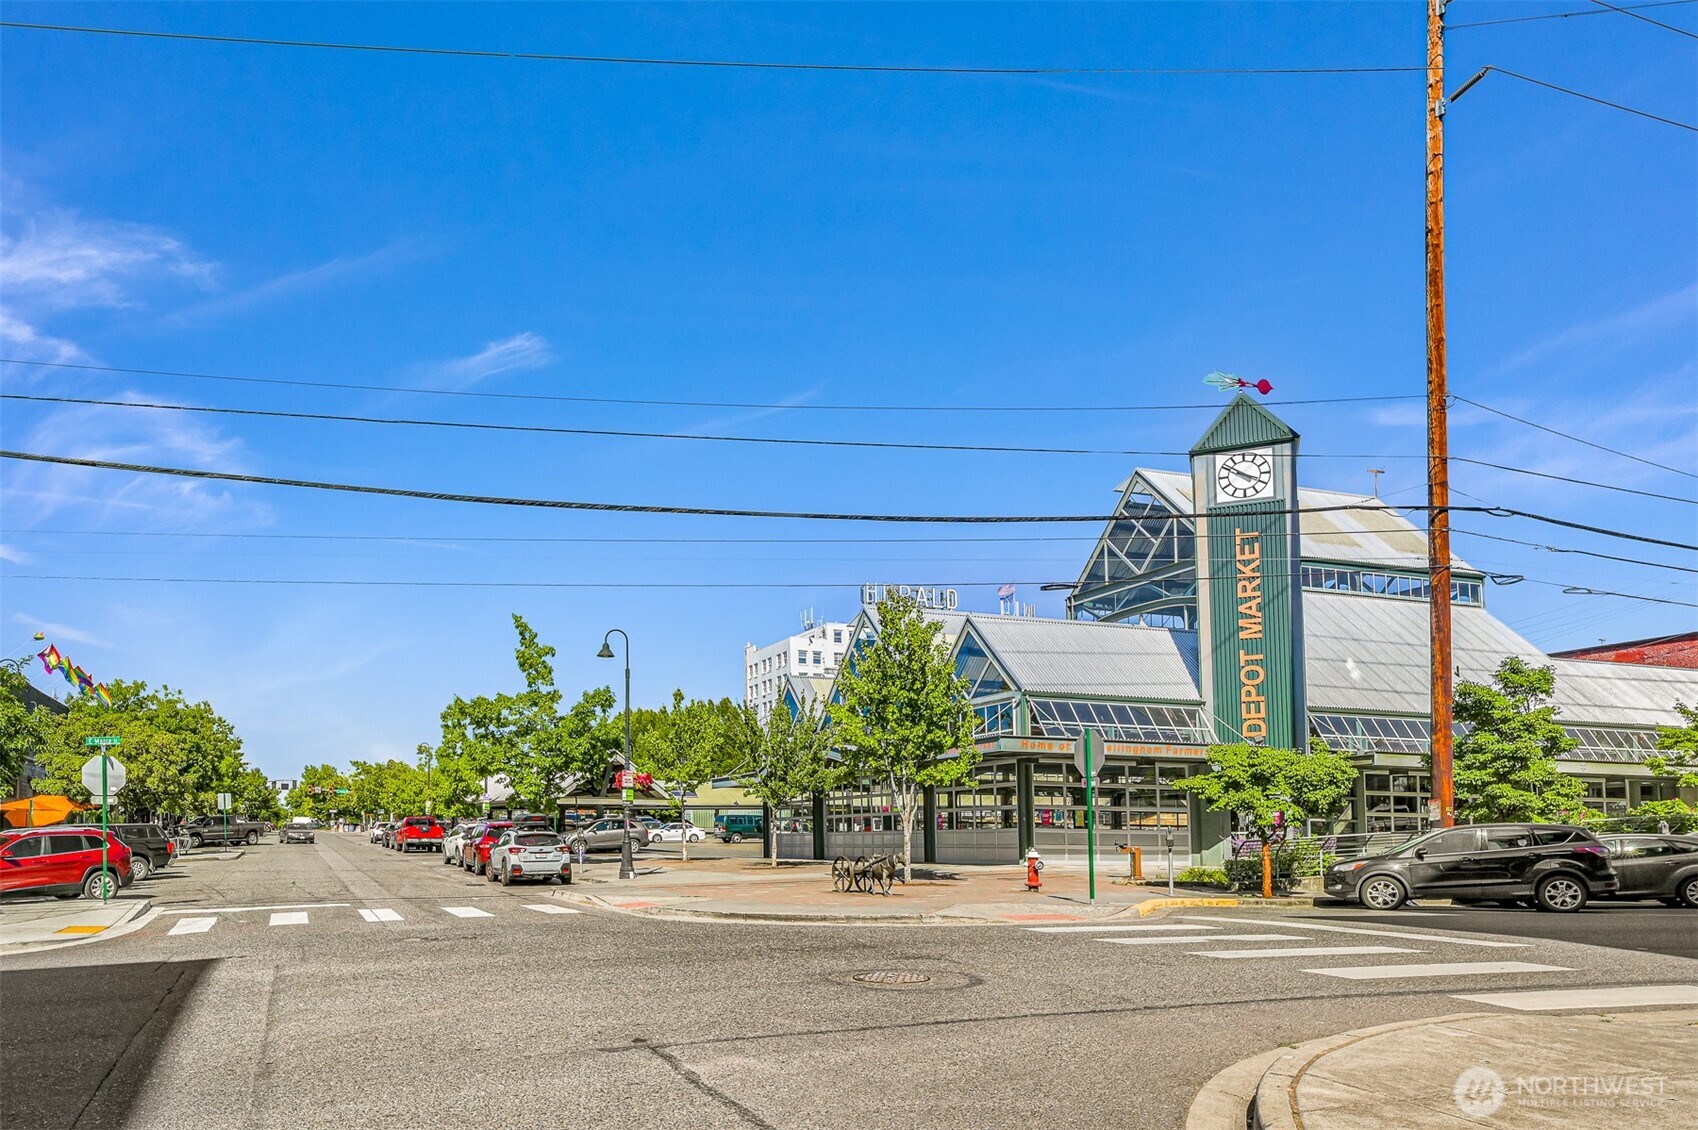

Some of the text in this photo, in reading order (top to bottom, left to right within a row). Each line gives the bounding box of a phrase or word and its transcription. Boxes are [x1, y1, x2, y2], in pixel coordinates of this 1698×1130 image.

[1235, 528, 1267, 738] DEPOT MARKET
[1021, 739, 1205, 757] Home of ellingham Farmer
